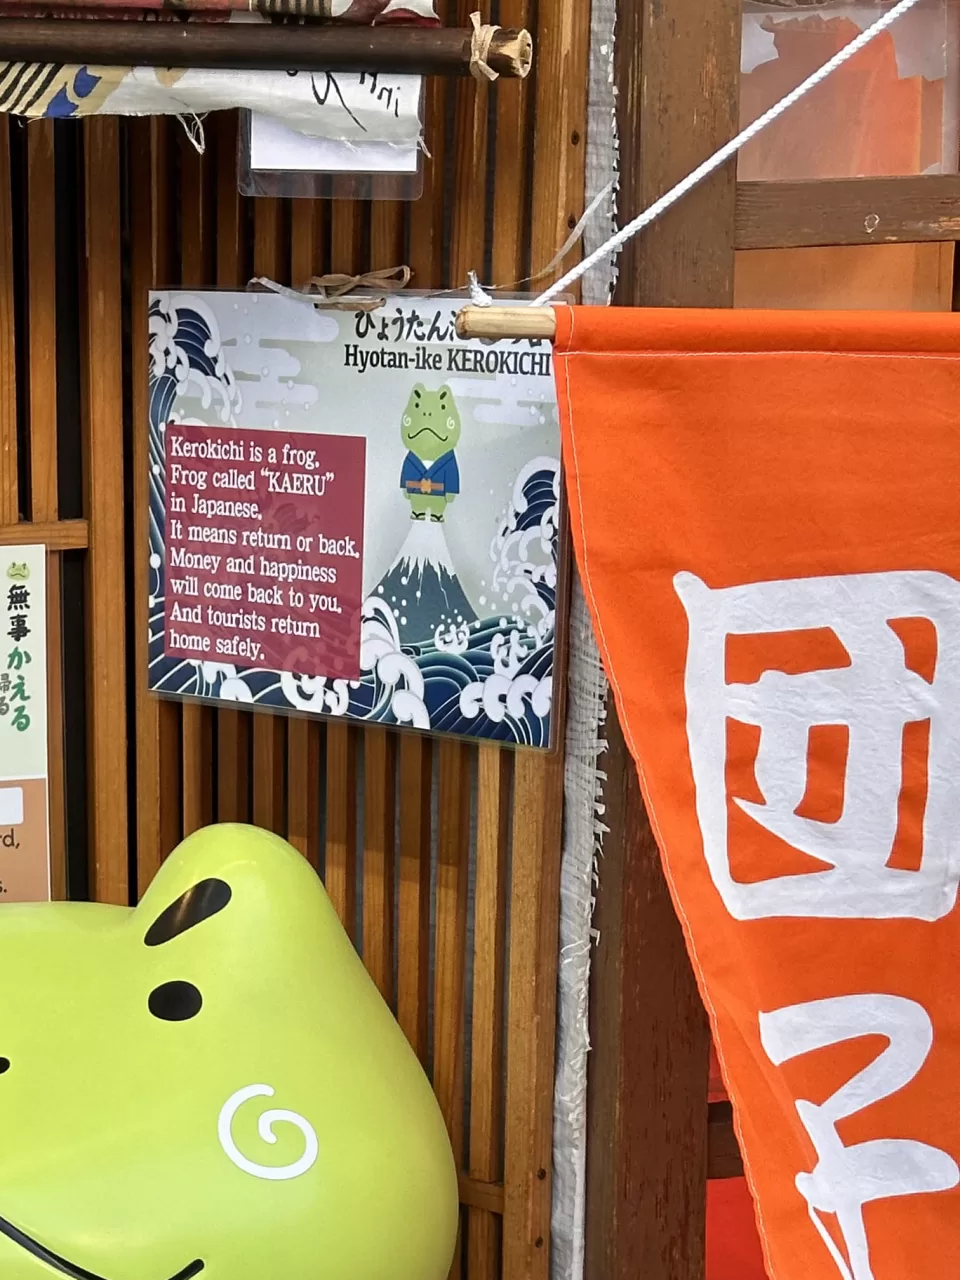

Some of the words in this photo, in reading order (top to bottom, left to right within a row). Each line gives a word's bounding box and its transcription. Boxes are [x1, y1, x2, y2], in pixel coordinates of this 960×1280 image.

[344, 344, 443, 373] Hyotan-ike
[447, 348, 551, 377] KEROKICHI
[171, 436, 244, 461] Kerokichi
[249, 441, 263, 463] is
[268, 449, 278, 464] a
[282, 444, 320, 471] frog.
[171, 464, 208, 490] Frog
[212, 467, 255, 491] called
[170, 492, 186, 512] in
[191, 493, 262, 520] Japanese.
[170, 520, 183, 540] It
[188, 525, 237, 545] means
[242, 528, 291, 550] return
[296, 535, 313, 551] or
[319, 534, 360, 559] back.
[170, 547, 221, 574] Money
[226, 555, 255, 575] and
[260, 556, 337, 584] happiness
[170, 576, 199, 596] will
[203, 583, 243, 600] come
[247, 583, 284, 606] back
[288, 586, 304, 608] to
[309, 594, 342, 614] you.
[170, 601, 202, 624] And
[207, 608, 266, 632] tourists
[270, 617, 320, 638] return
[7, 584, 32, 732] 無事かえる
[169, 629, 210, 651] home
[215, 636, 265, 661] safely.
